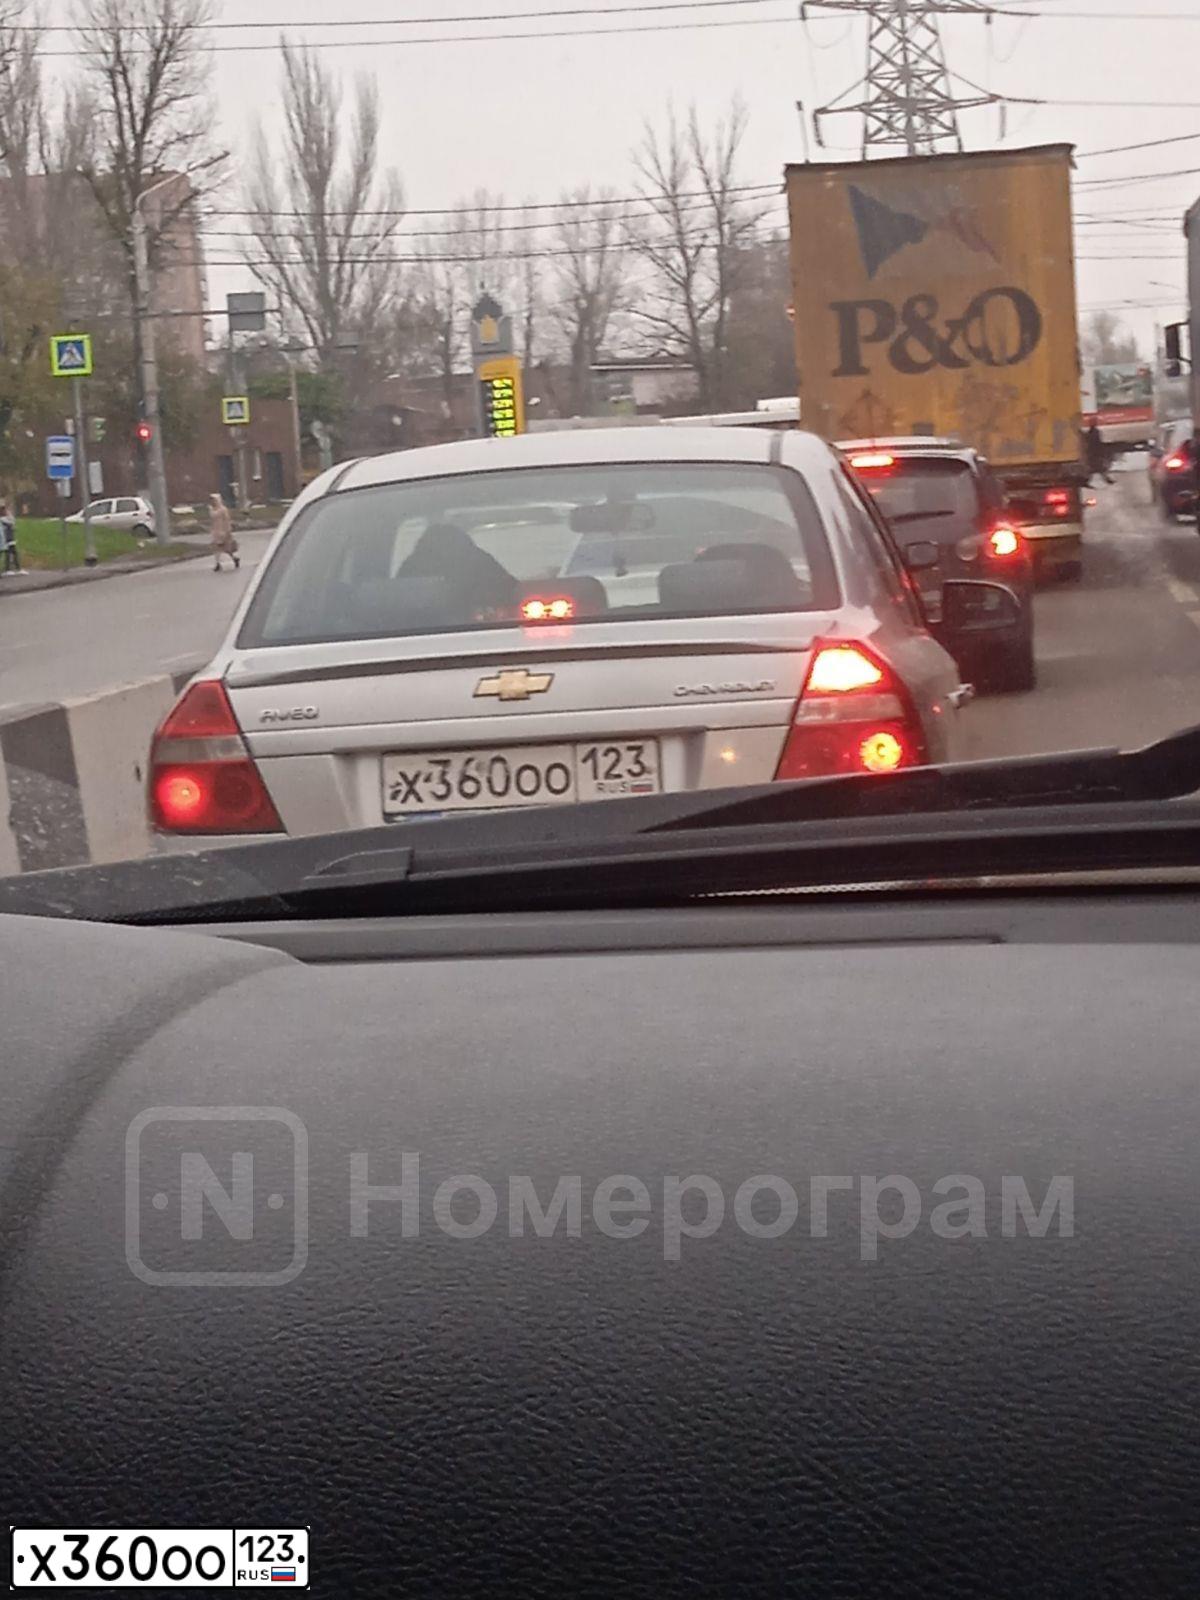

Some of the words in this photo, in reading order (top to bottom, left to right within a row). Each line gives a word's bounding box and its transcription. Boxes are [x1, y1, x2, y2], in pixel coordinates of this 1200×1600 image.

[828, 286, 1042, 377] P&O
[581, 745, 647, 781] 123
[596, 780, 630, 794] RUS
